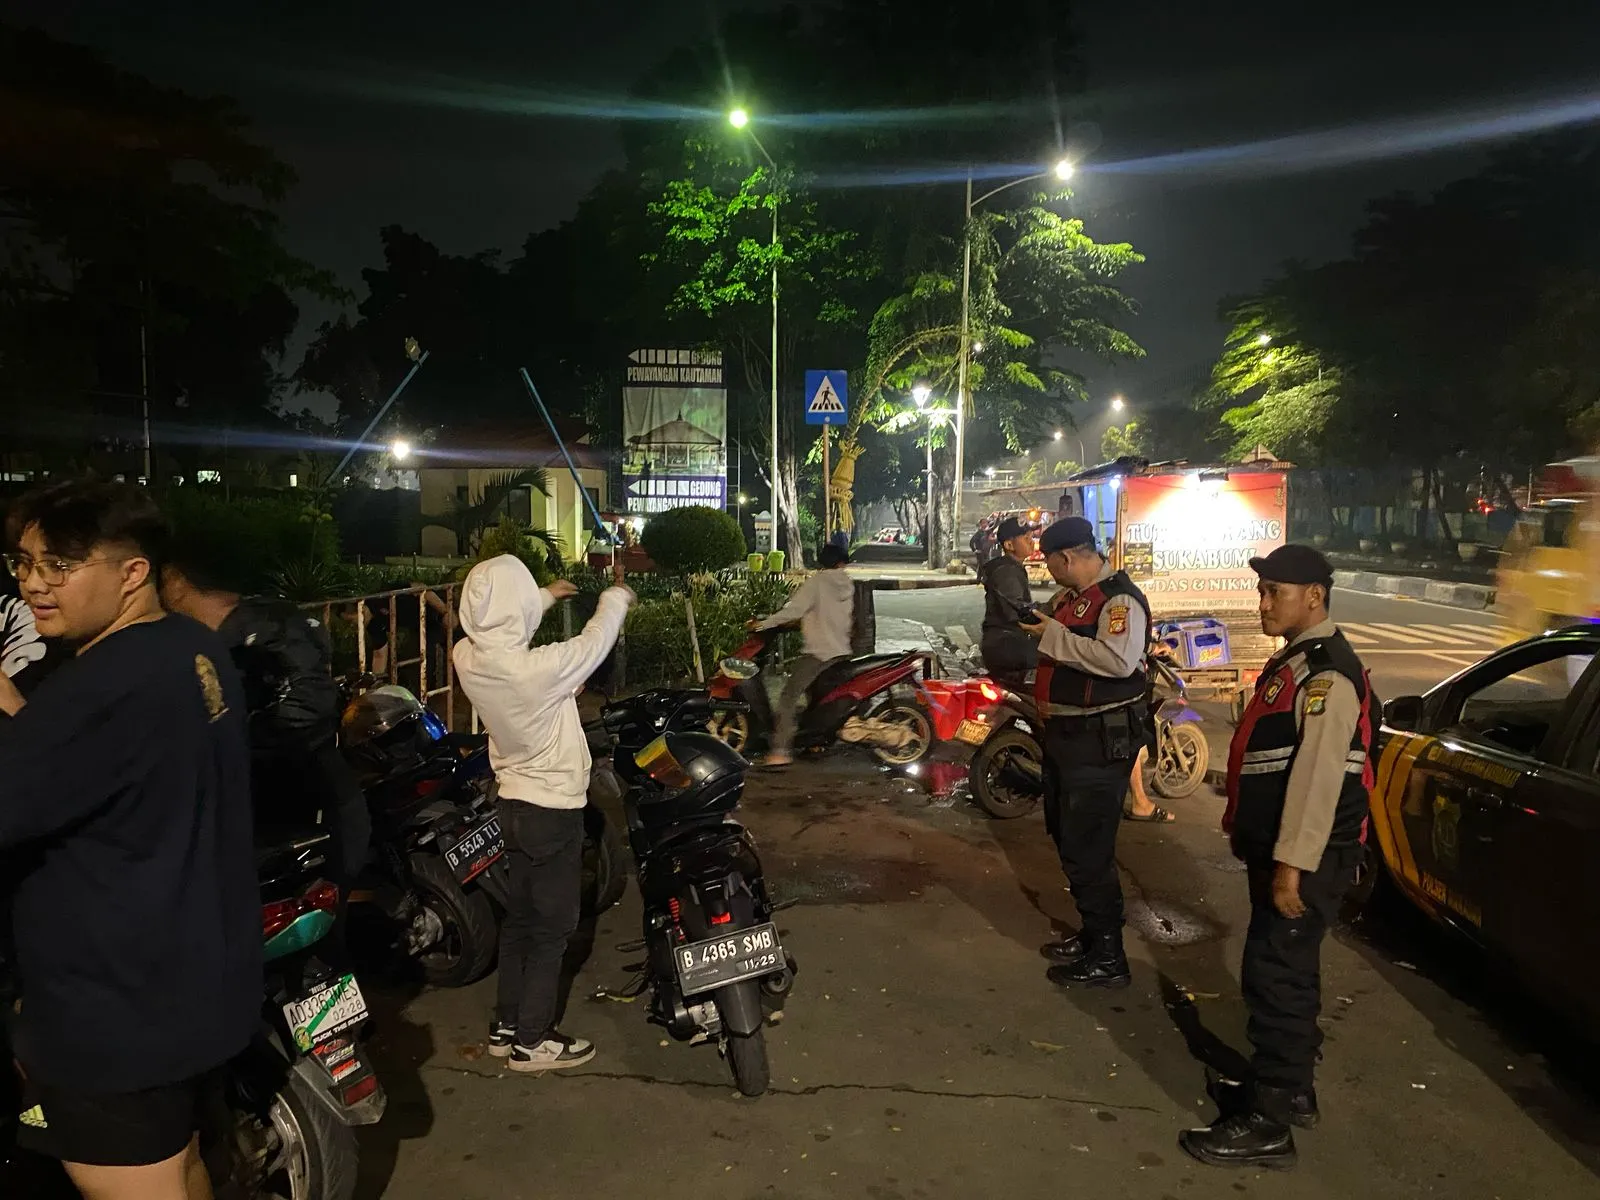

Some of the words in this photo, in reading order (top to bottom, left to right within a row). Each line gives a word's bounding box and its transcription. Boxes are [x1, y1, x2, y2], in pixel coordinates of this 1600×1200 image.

[628, 367, 678, 382] PEWAYANGAN
[680, 367, 722, 383] KAUTAMAN
[690, 481, 721, 497] GEDUNG
[1192, 578, 1204, 592] &
[1209, 578, 1260, 592] NIKM
[448, 852, 459, 866] B
[460, 833, 485, 857] 5548
[683, 950, 694, 968] B
[702, 940, 737, 963] 4365
[743, 931, 772, 953] SMB
